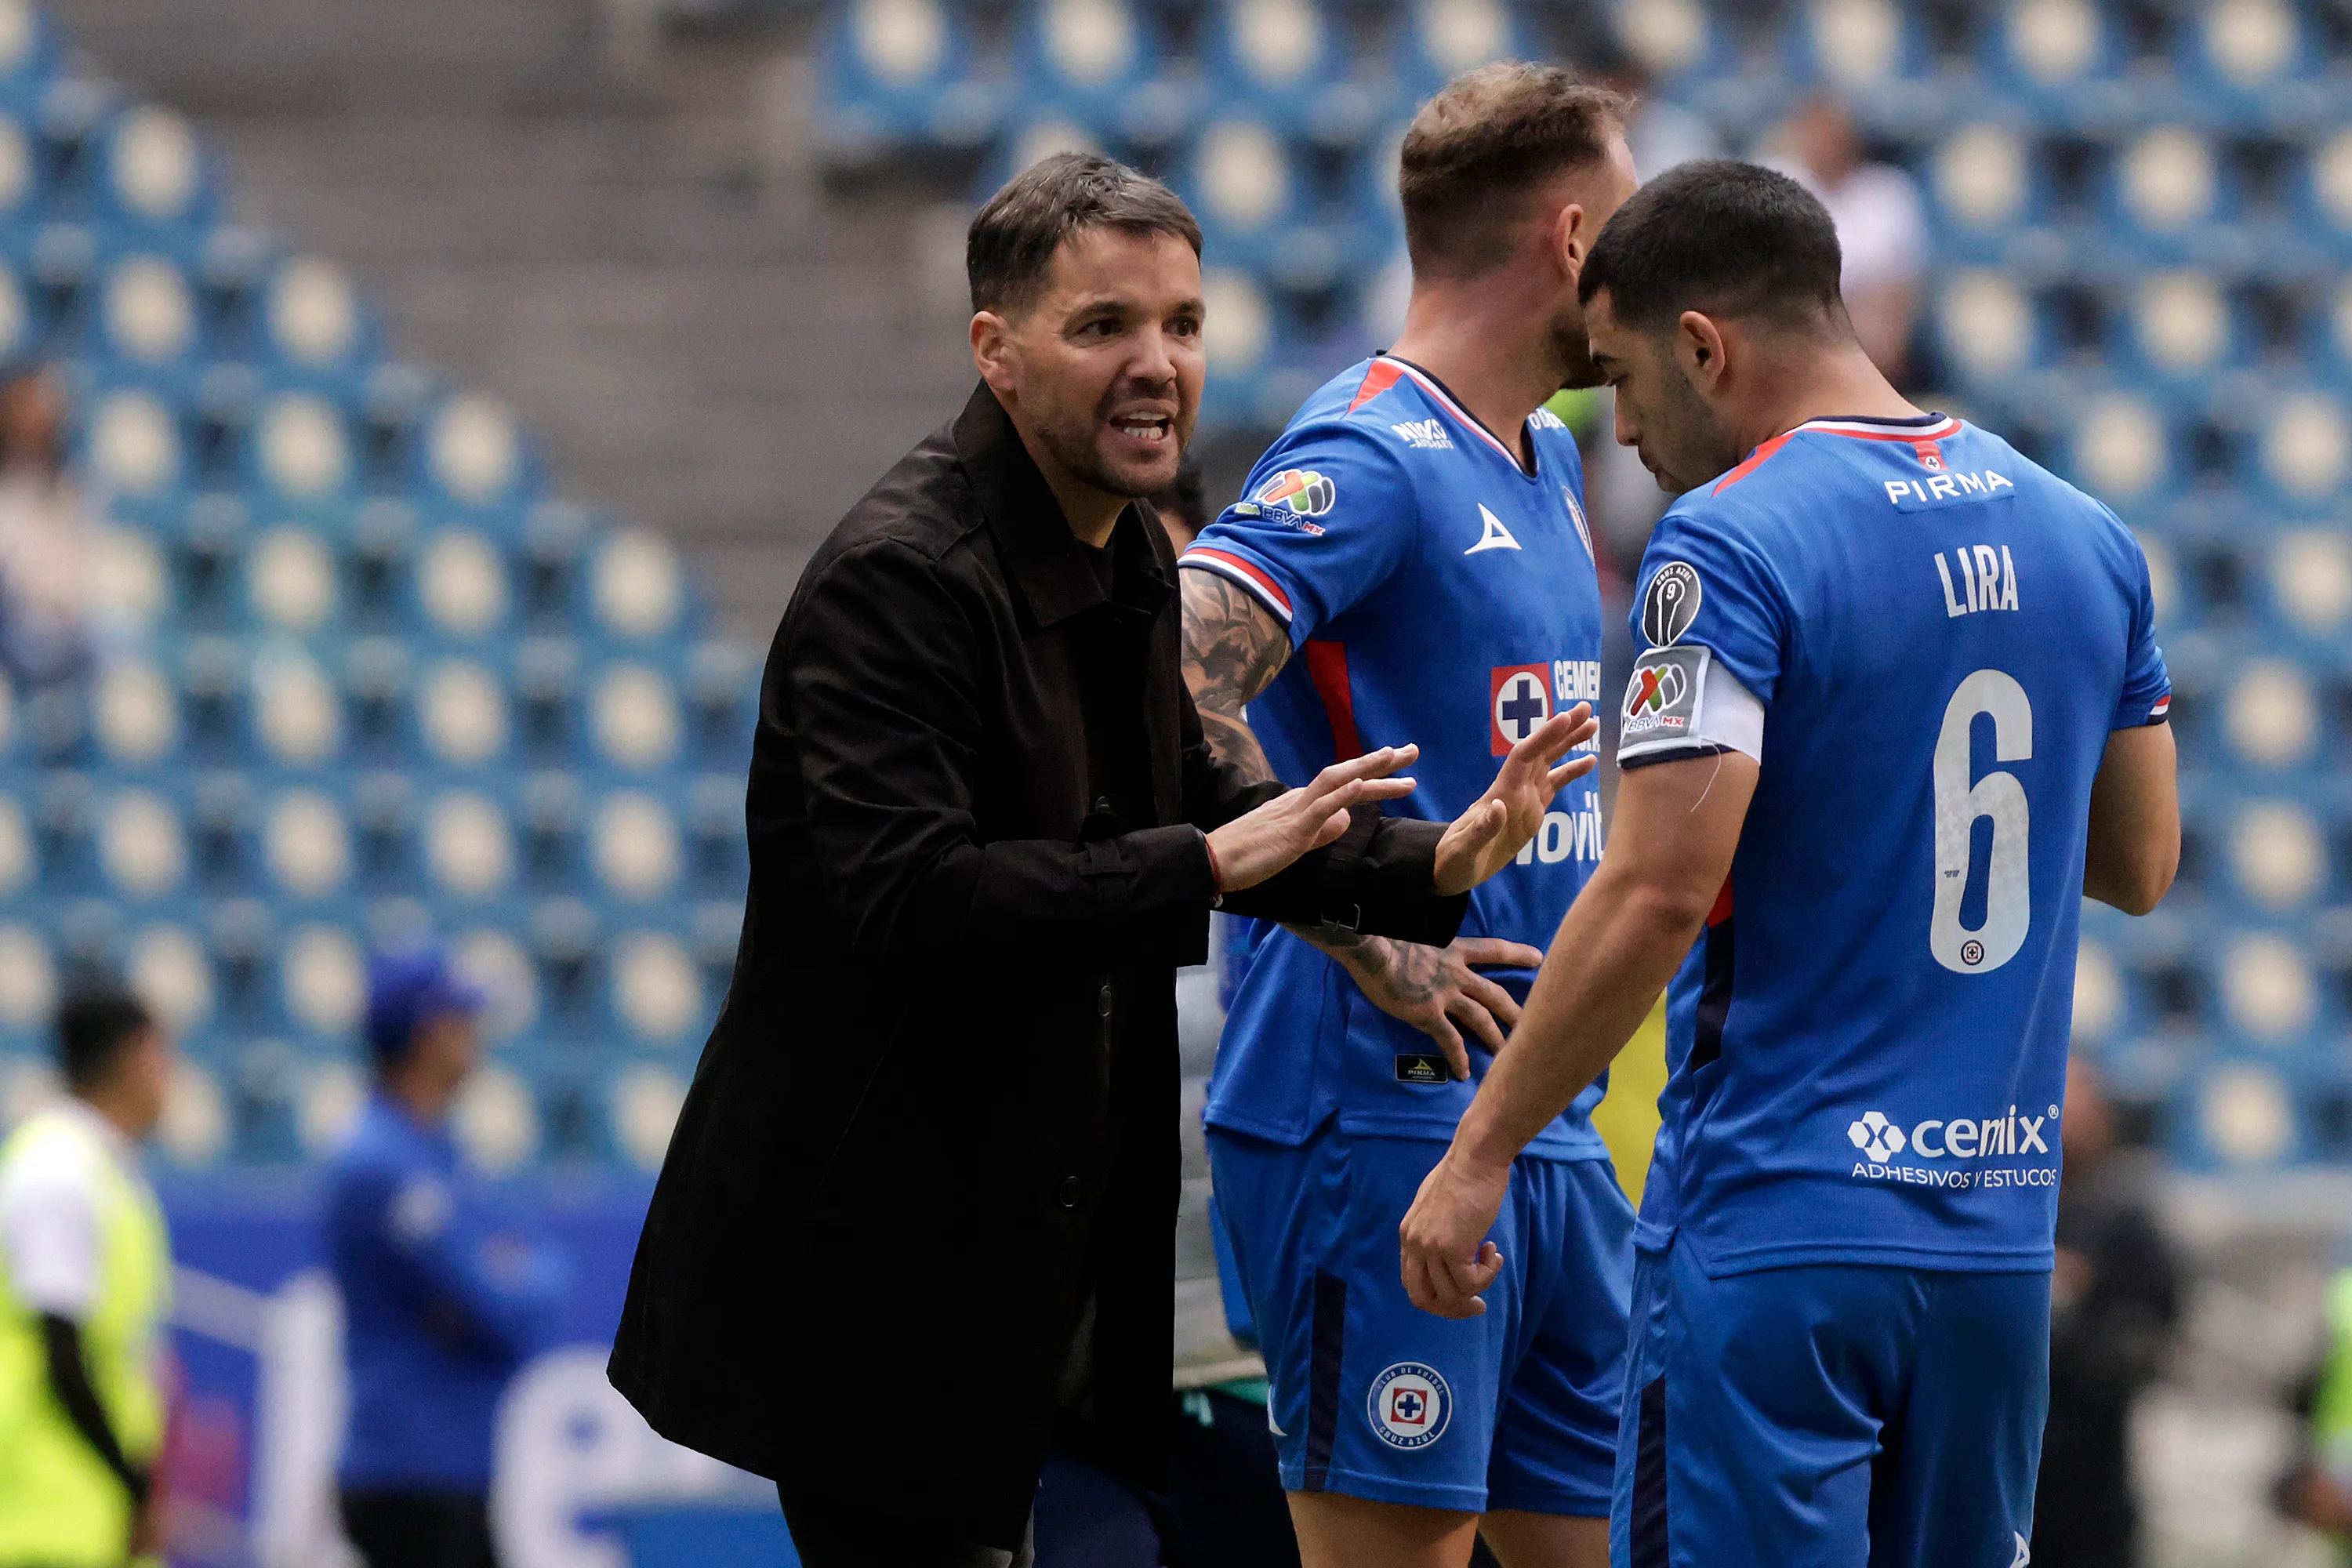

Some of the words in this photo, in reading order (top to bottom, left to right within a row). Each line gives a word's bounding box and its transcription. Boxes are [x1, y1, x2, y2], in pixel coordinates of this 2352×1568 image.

[1883, 469, 2015, 504] PIRMA
[1262, 505, 1302, 530] BBVA
[1301, 521, 1327, 537] MX
[1656, 567, 1674, 586] CRUZ
[1675, 566, 1692, 582] AZUL
[1933, 544, 2020, 618] LIRA
[1666, 583, 1676, 600] 9
[1626, 714, 1661, 734] BBVA
[1660, 715, 1685, 728] MX
[1930, 668, 2033, 975] 6
[1911, 1104, 2049, 1158] cemix
[1851, 1162, 1972, 1189] ADHESIVOS
[1973, 1170, 1982, 1188] Y
[1984, 1168, 2057, 1188] ESTUCOS
[1379, 1425, 1403, 1445] CRUZ
[1407, 1431, 1435, 1446] AZUL
